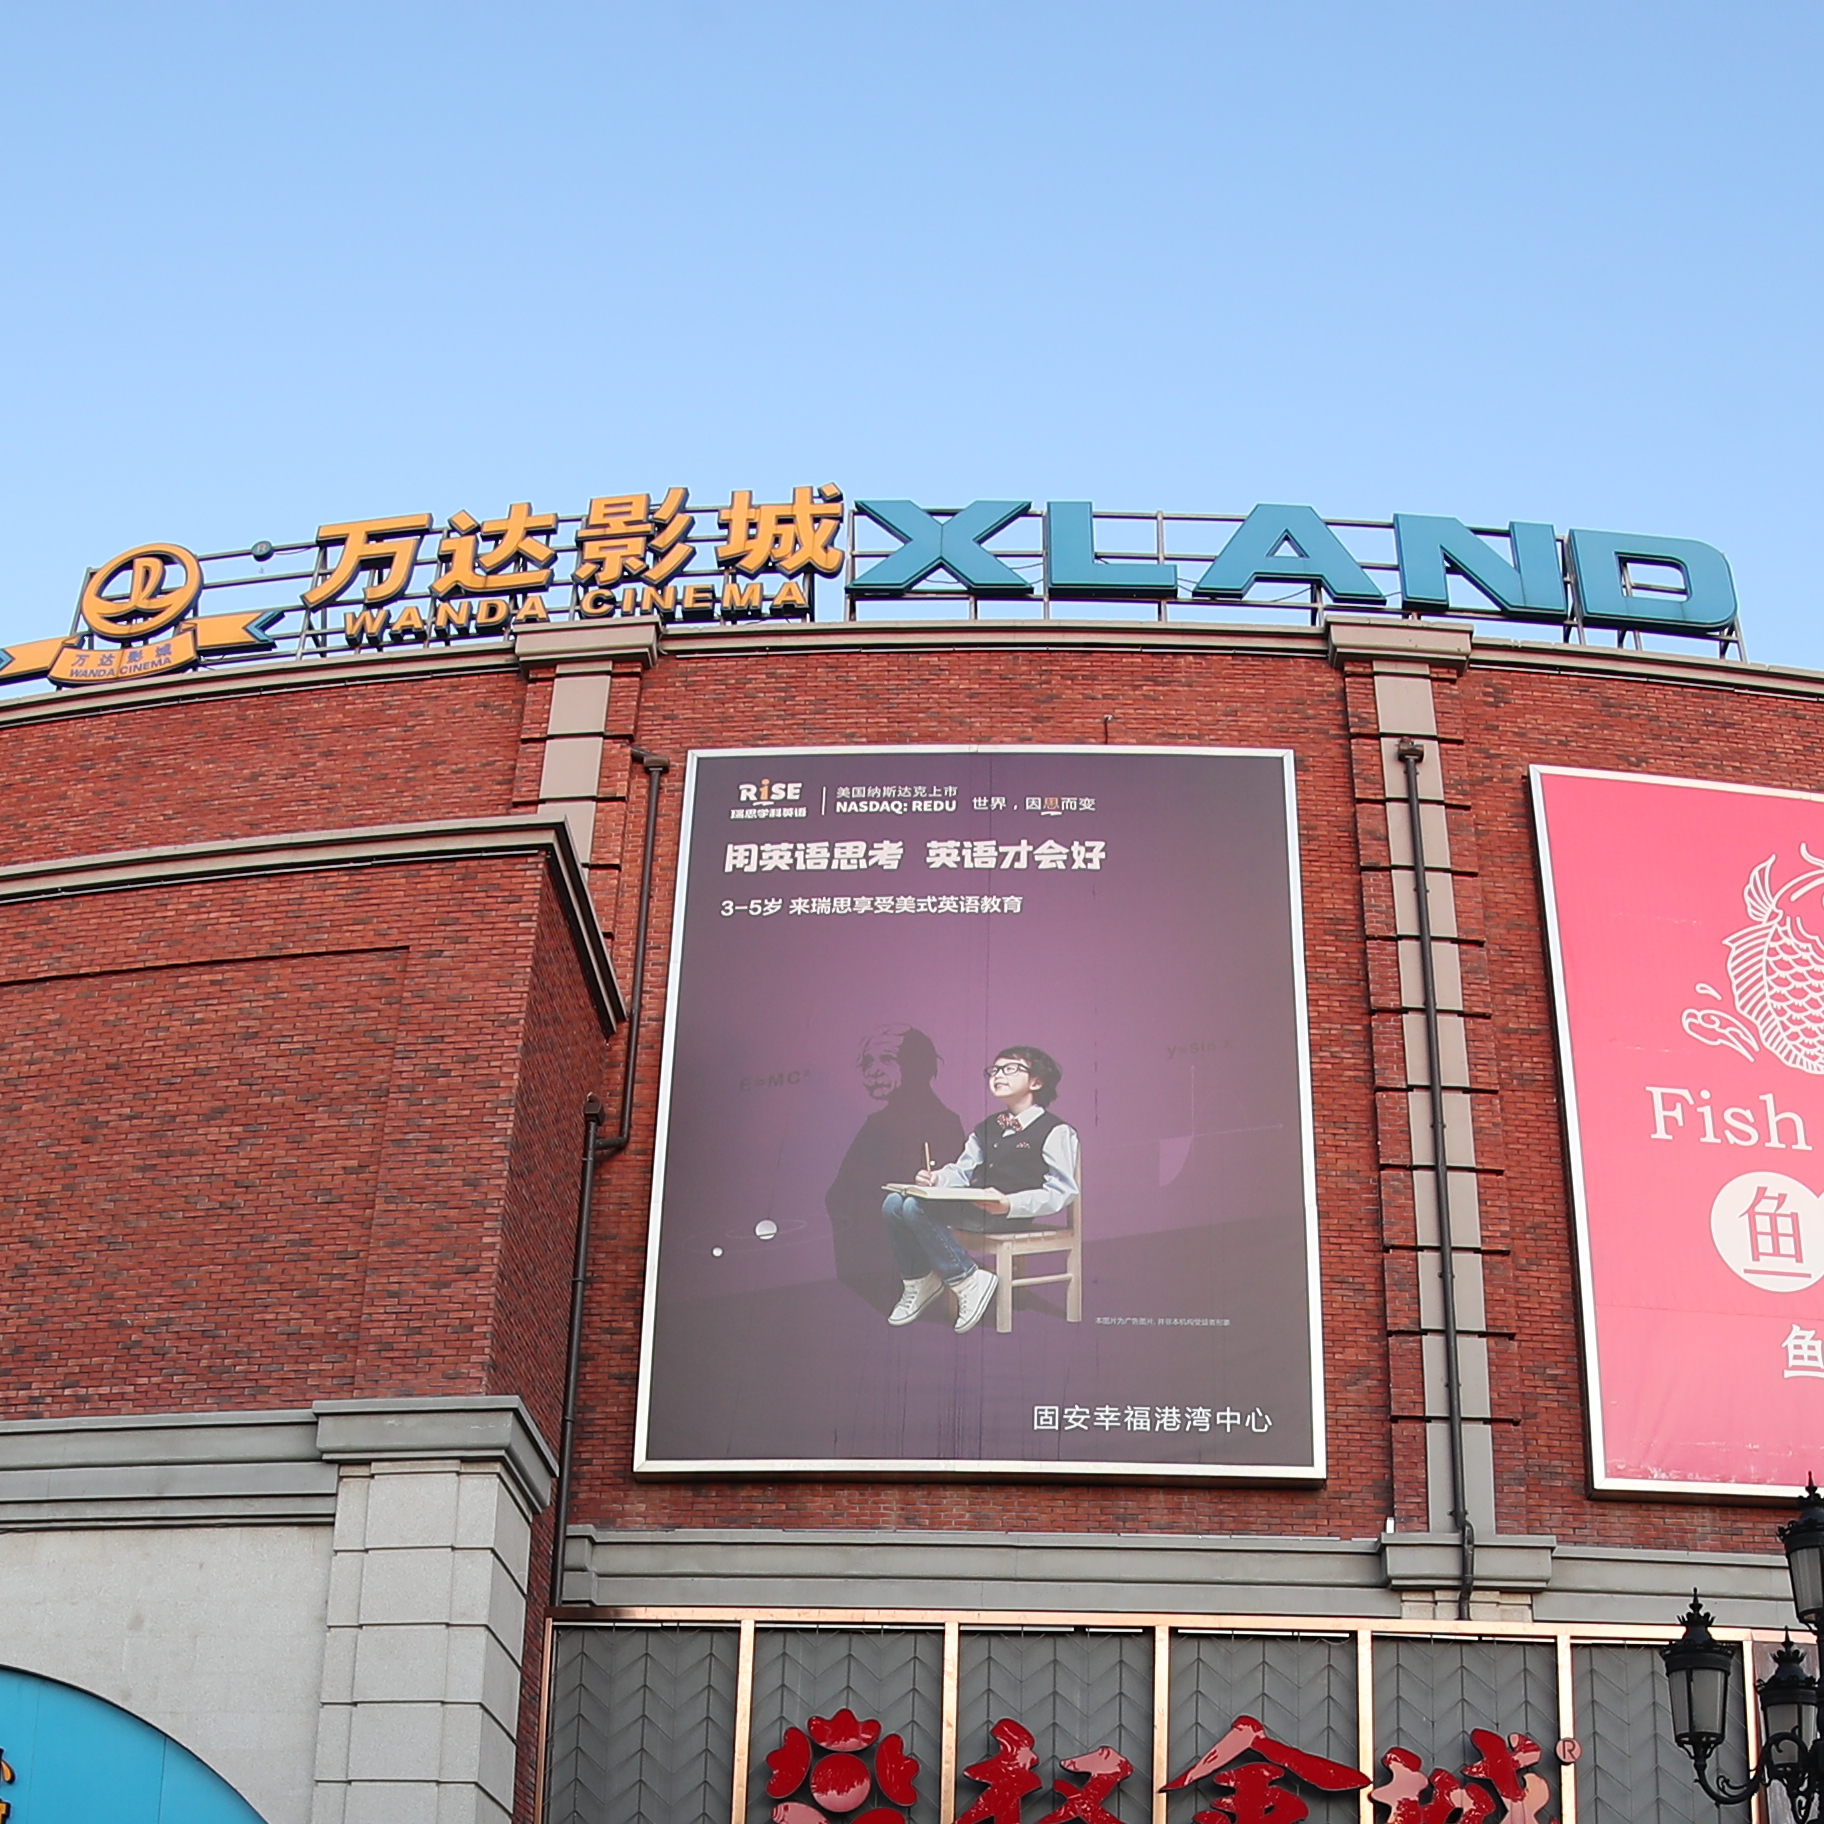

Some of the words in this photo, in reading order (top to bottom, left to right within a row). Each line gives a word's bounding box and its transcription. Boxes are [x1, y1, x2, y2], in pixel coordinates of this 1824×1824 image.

[302, 481, 846, 610] 万达影城
[845, 499, 1738, 633] XLAND
[343, 594, 551, 648] WANDA
[579, 581, 810, 619] CINEMA
[69, 666, 116, 678] WANDA
[119, 656, 173, 676] CINEMA
[71, 642, 173, 668] 万达影城
[835, 785, 959, 799] 美国纳斯达克上市
[835, 799, 909, 816] NASDAQ:
[911, 799, 958, 813] REDU
[724, 840, 905, 874] 用英语思考
[925, 838, 1107, 871] 英语才会好
[788, 895, 1025, 916] 来瑞思享受美式英语教育
[1645, 1086, 1813, 1152] Fish
[1033, 1403, 1274, 1434] 固安幸福港湾中心
